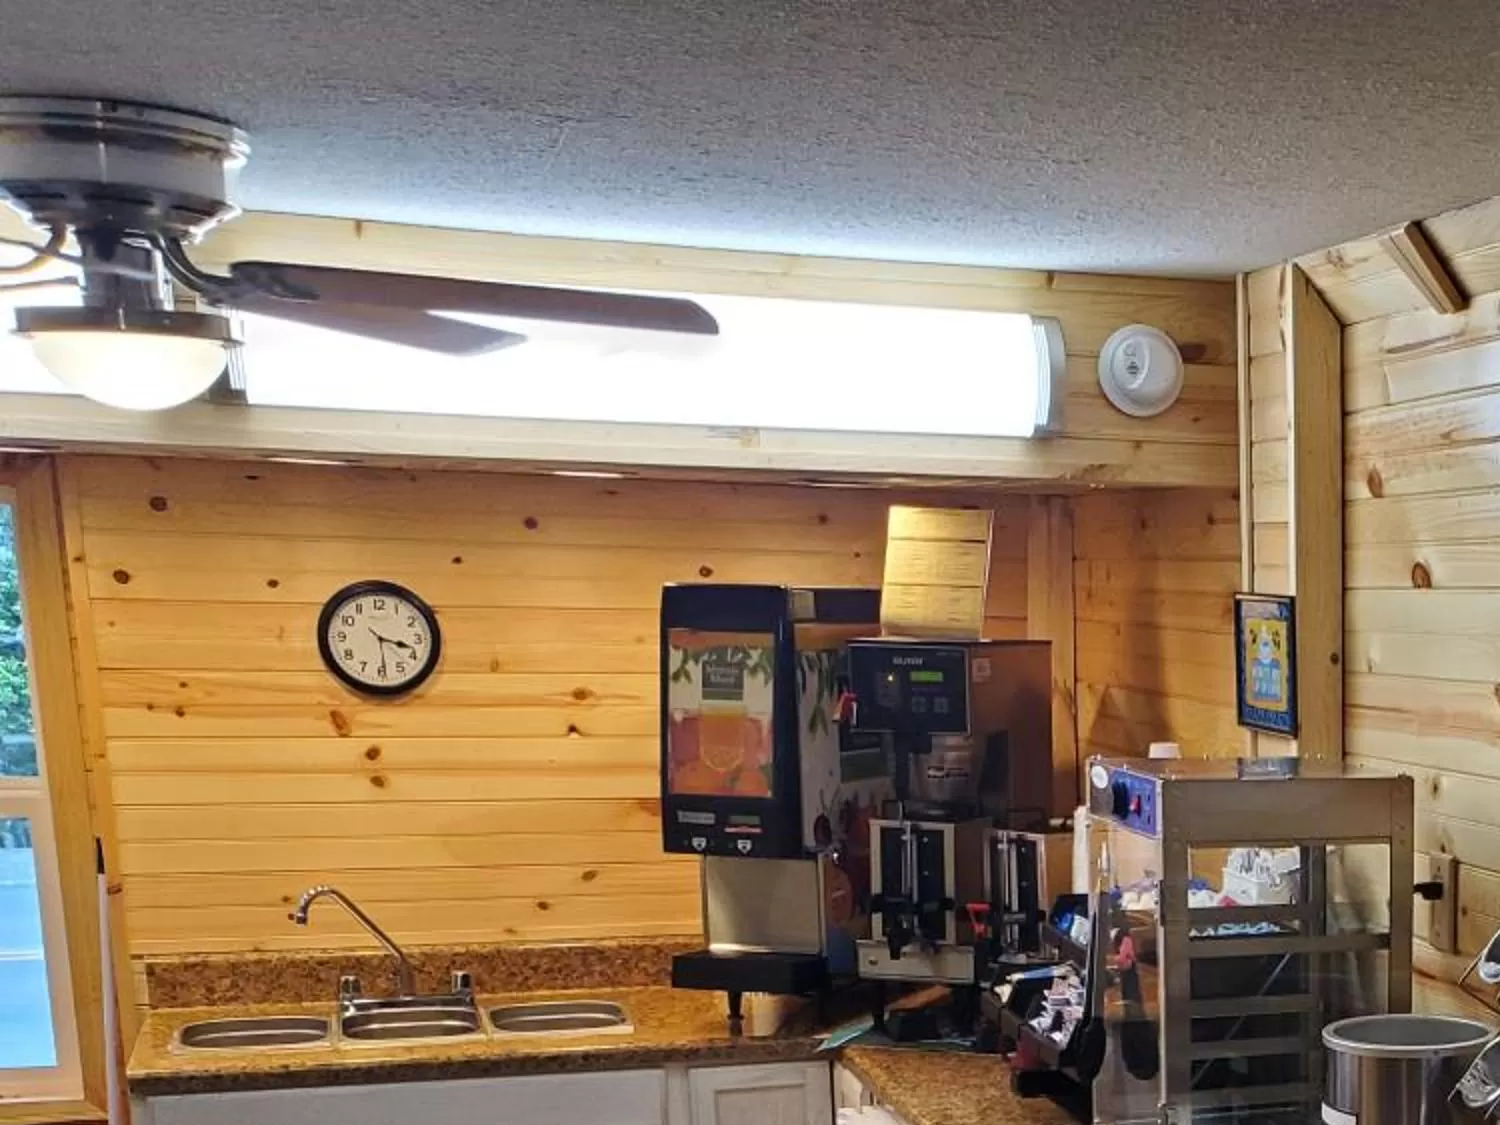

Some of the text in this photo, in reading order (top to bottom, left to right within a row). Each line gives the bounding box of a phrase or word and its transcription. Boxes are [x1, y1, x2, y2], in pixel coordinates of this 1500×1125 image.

[355, 603, 363, 615] 11
[373, 599, 386, 610] 12
[341, 615, 355, 626] 10
[407, 616, 416, 628] 2
[336, 631, 347, 642] 9
[413, 633, 423, 645] 3
[343, 649, 354, 660] 8
[408, 648, 417, 661] 4
[360, 661, 368, 673] 7
[377, 665, 386, 677] 6
[395, 662, 405, 673] 5
